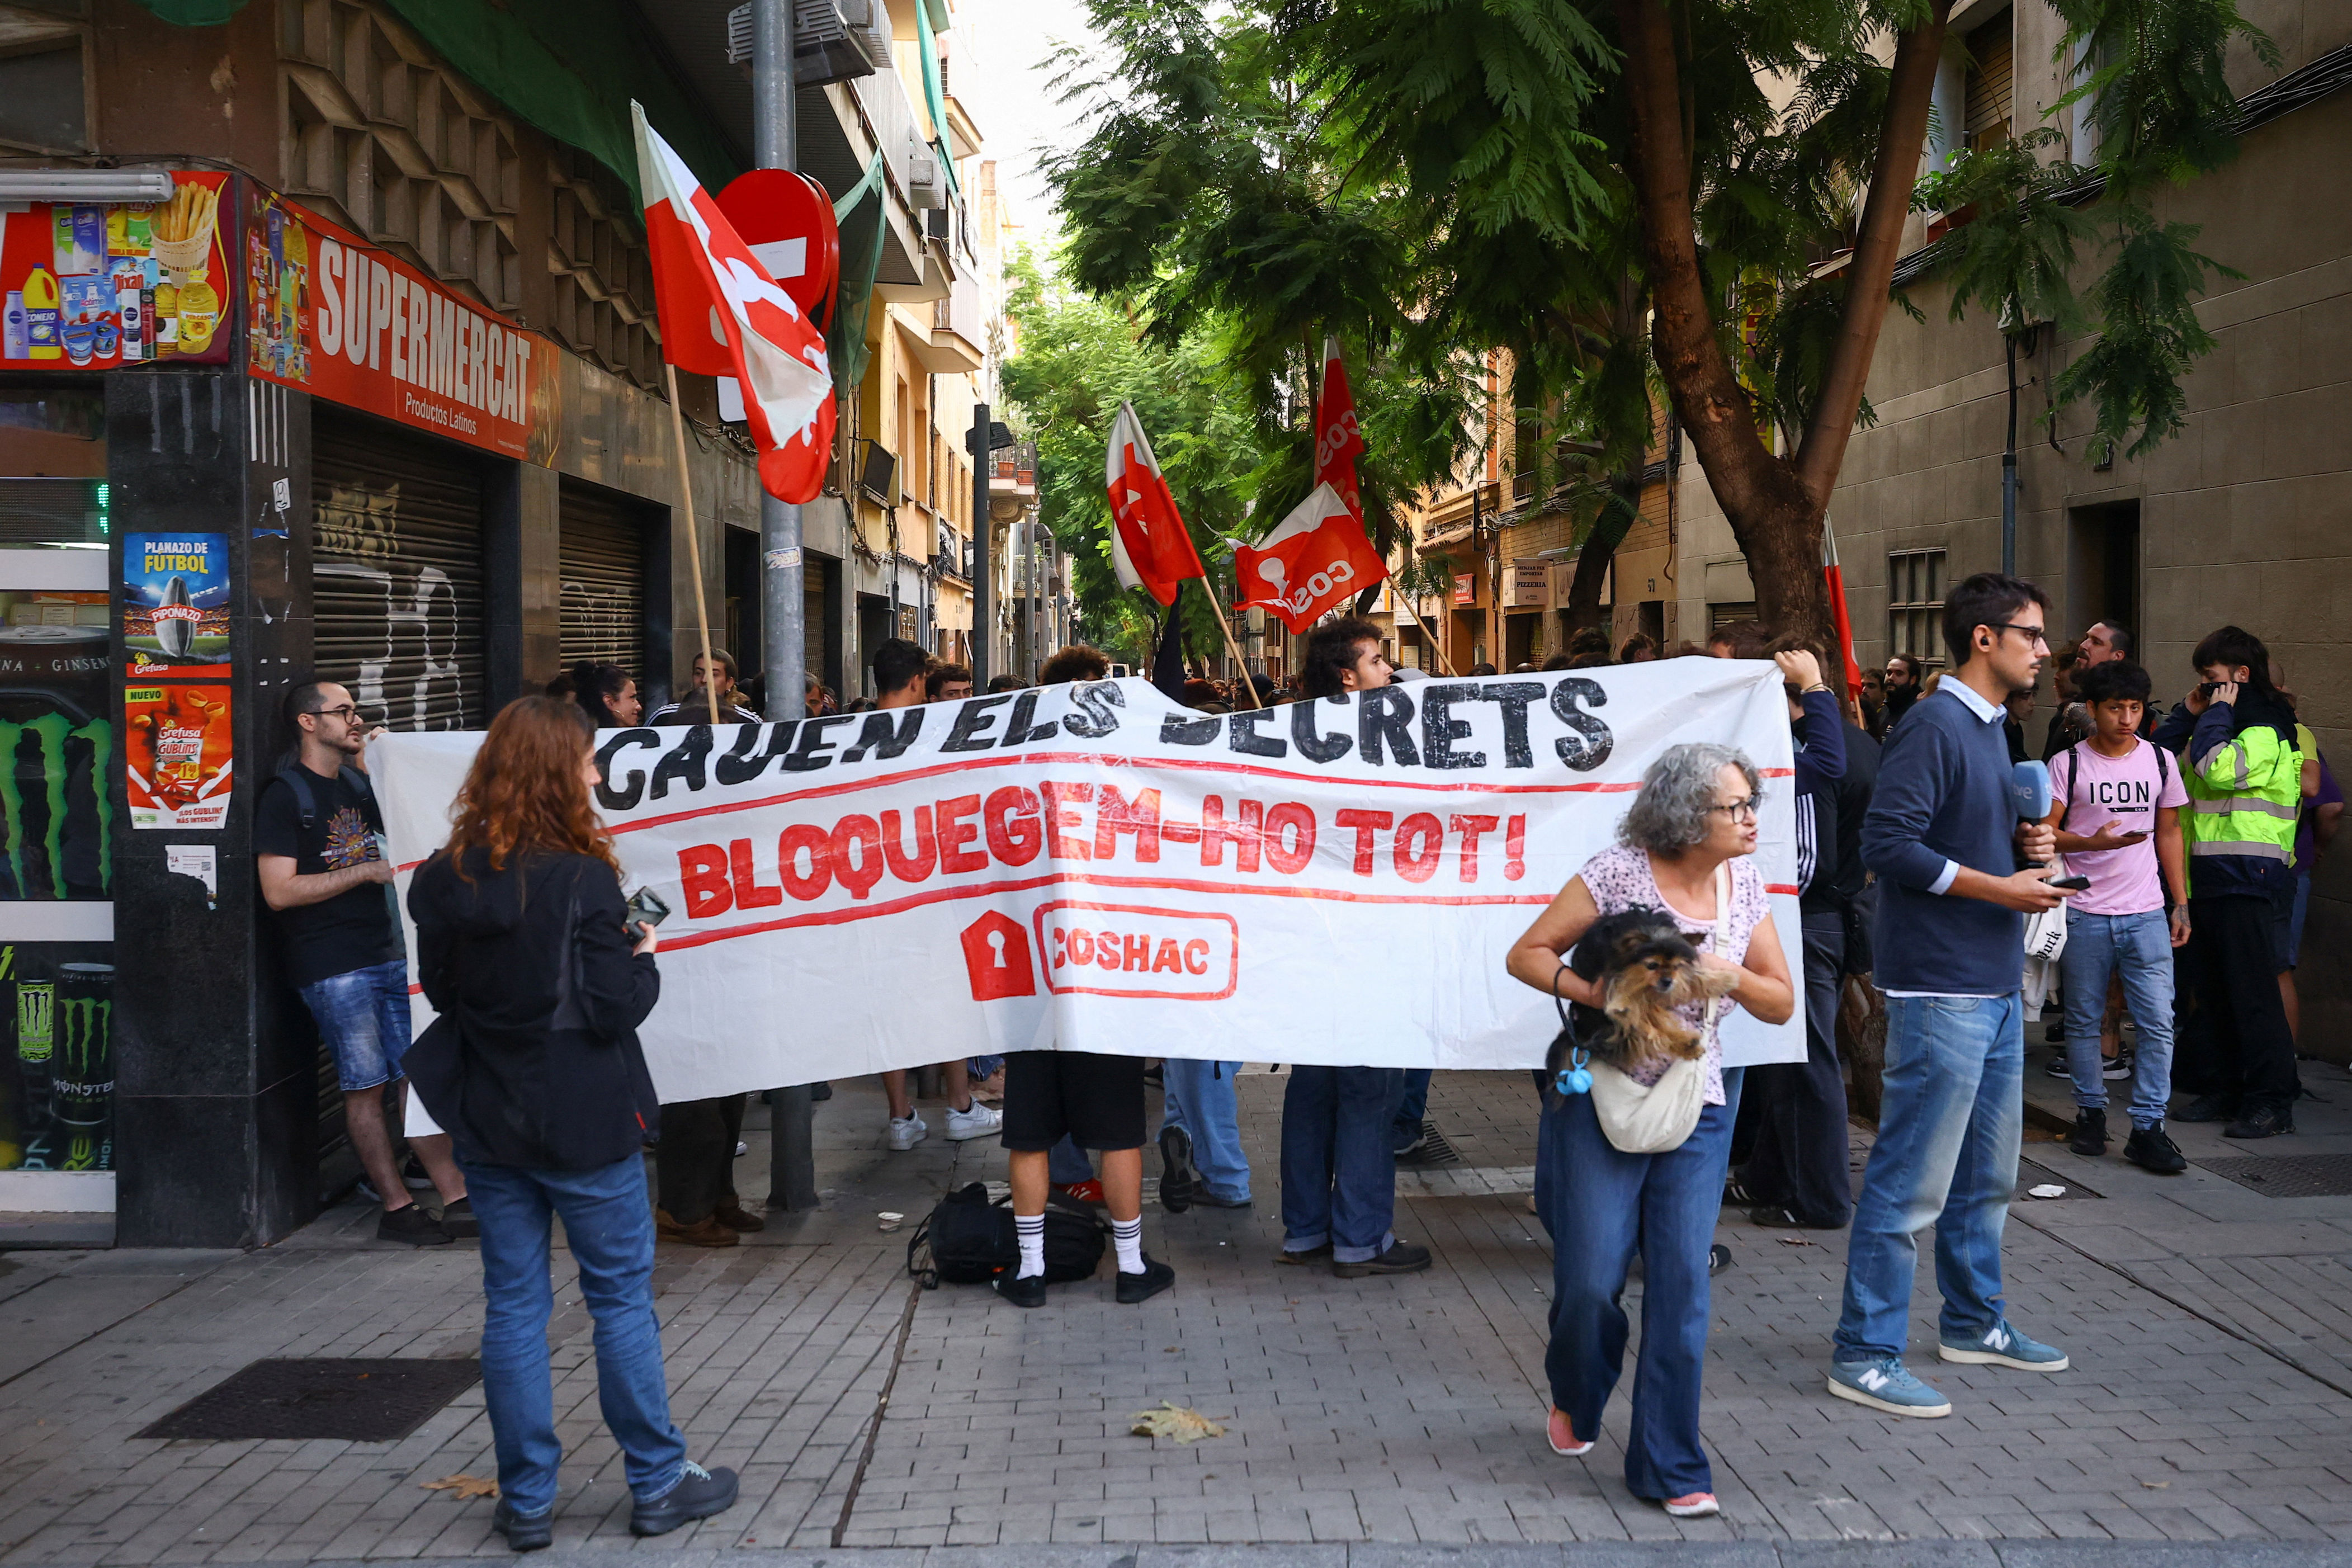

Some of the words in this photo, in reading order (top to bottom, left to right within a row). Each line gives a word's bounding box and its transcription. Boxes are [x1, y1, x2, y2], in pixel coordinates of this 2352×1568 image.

[318, 235, 531, 426] SUPERMERCAT
[405, 391, 448, 426] Productos
[449, 407, 477, 435] Latinos
[144, 541, 192, 554] PLANAZO
[193, 542, 209, 554] DE
[144, 551, 209, 574] FÚTBOL
[134, 663, 168, 674] Grefusa
[130, 690, 162, 700] NUEVO
[938, 680, 1126, 752] ELS
[159, 726, 201, 739] Grefusa
[2089, 781, 2150, 805] ICON
[677, 780, 1316, 920] BLOQUEGEM-HO
[1335, 808, 1526, 884] TOT!
[1053, 927, 1210, 975] COSHAC
